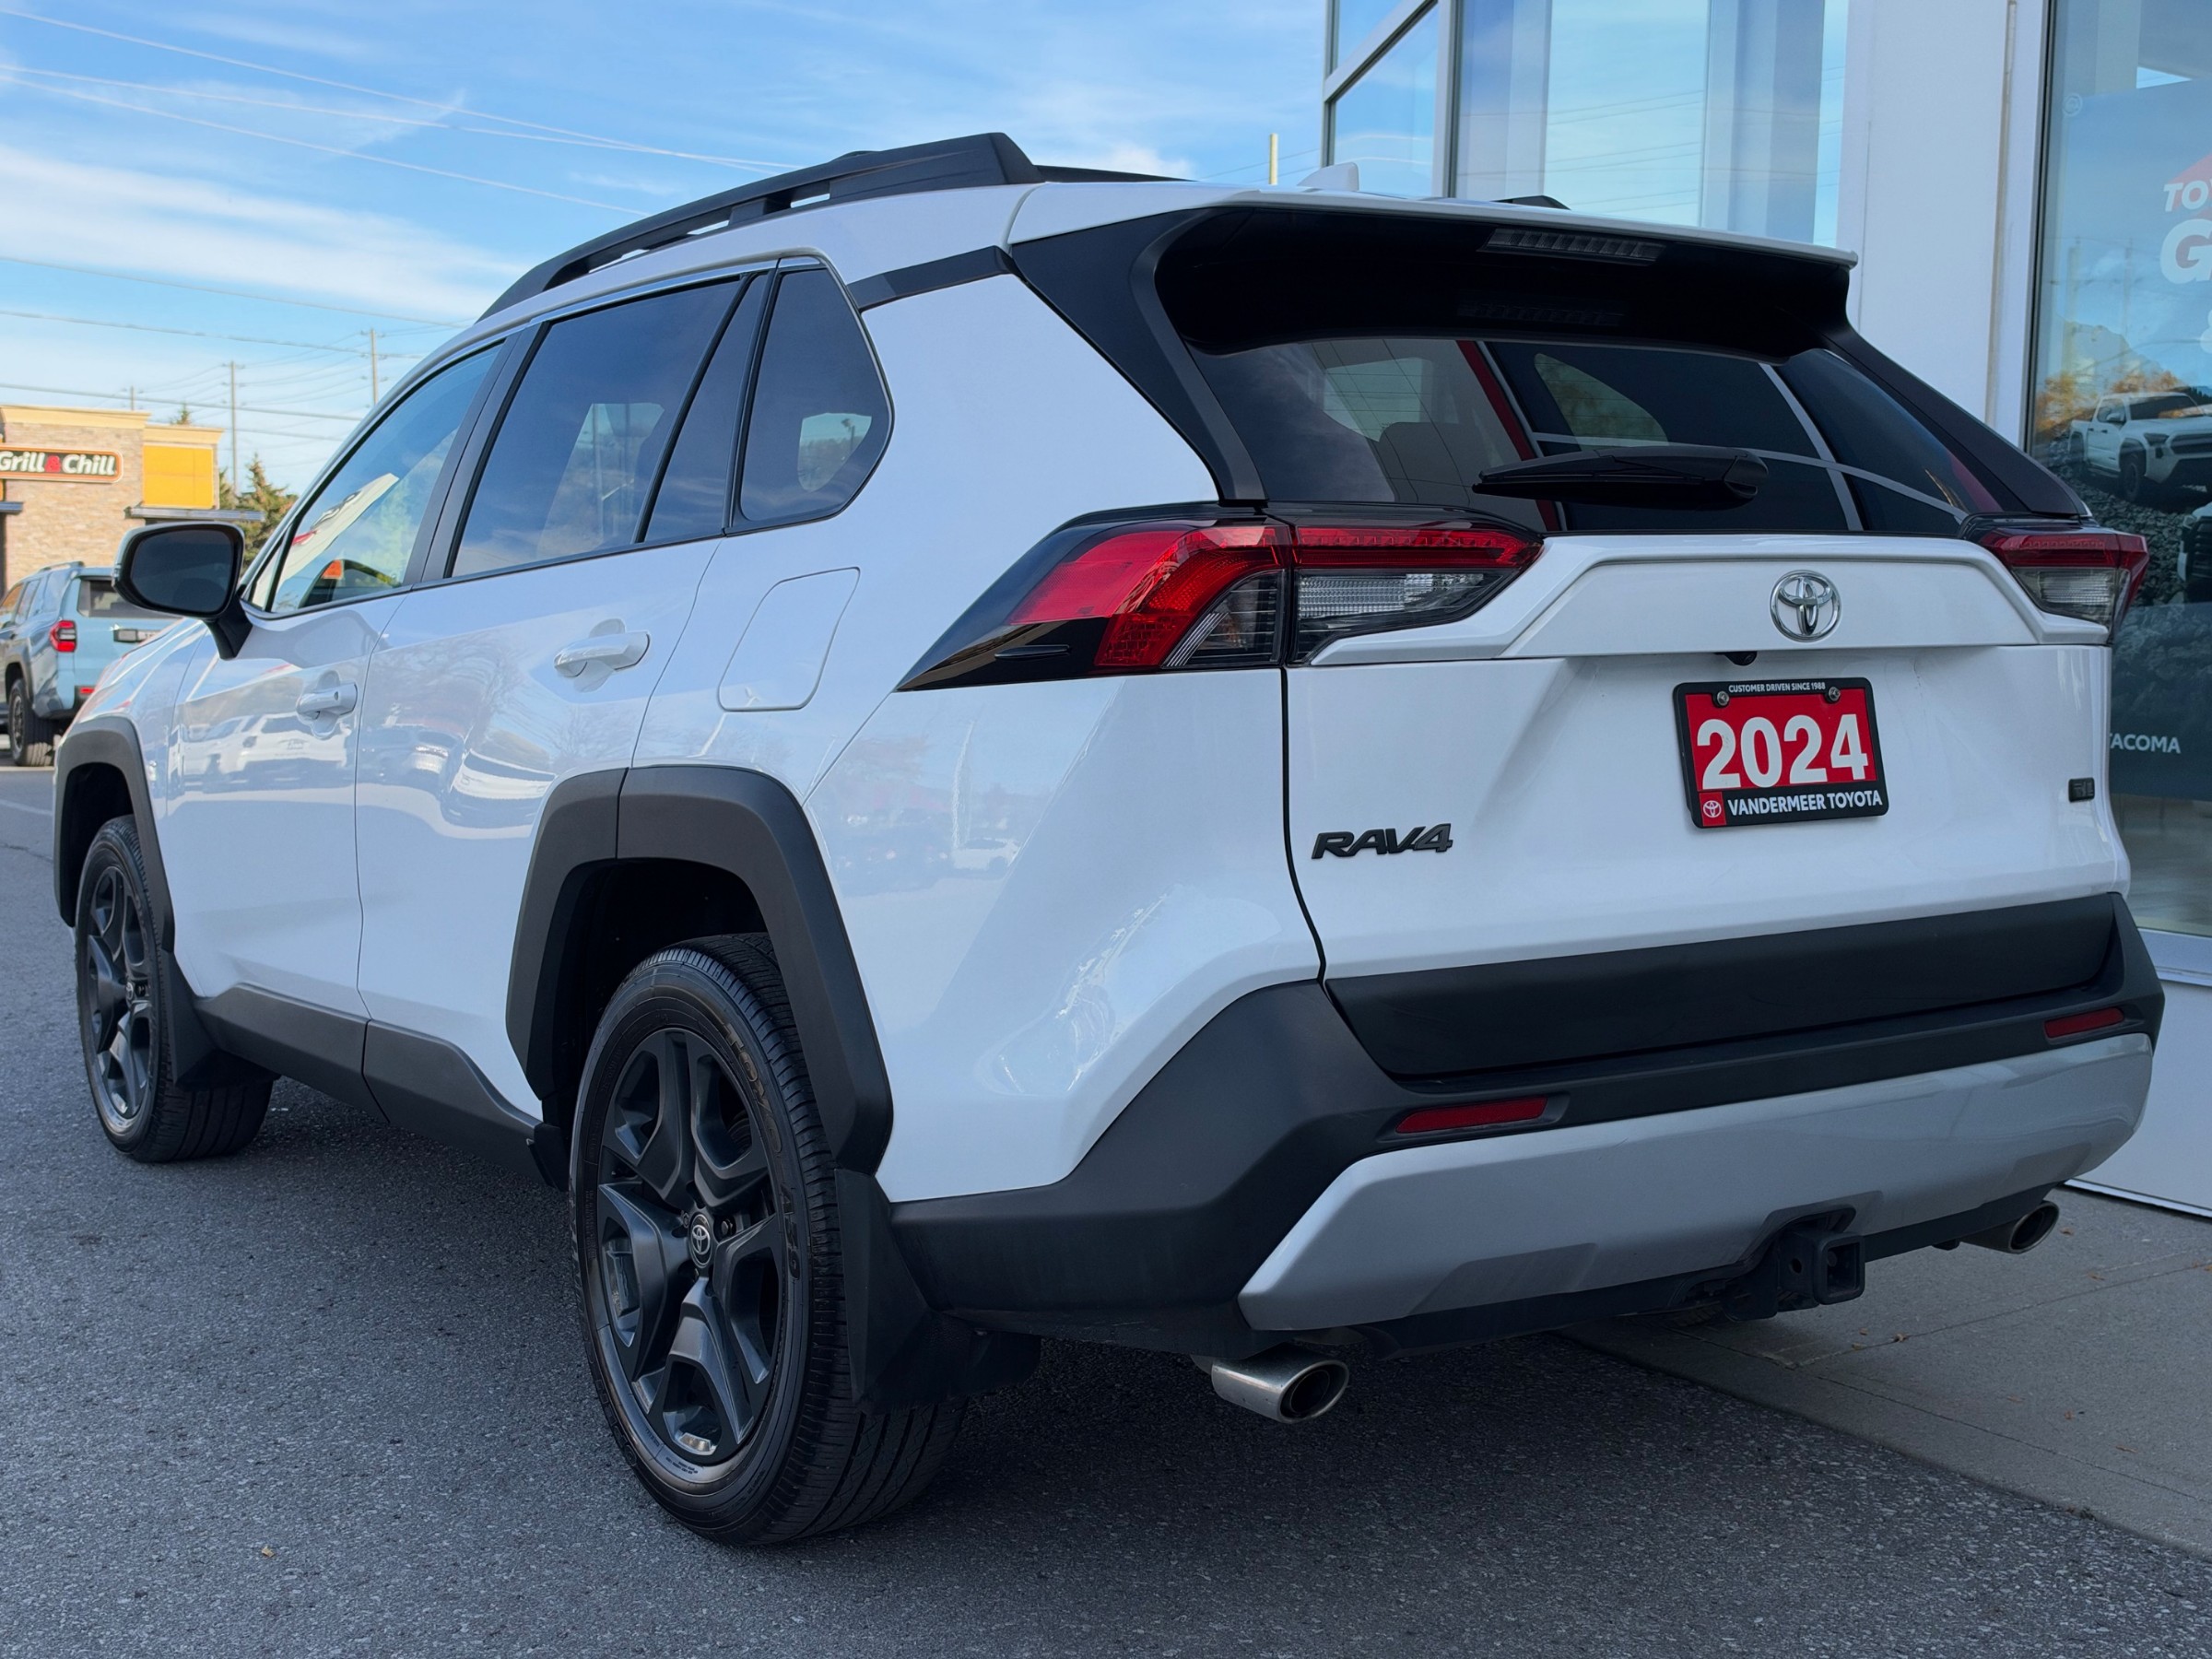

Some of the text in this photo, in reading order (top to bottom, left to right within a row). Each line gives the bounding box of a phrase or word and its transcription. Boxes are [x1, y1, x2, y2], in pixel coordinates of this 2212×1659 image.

[0, 451, 45, 473] Grill
[62, 453, 115, 476] Chill
[1728, 681, 1826, 693] CUSTOMER DRIVEN SINCE 1988
[1697, 713, 1869, 790] 2024
[2110, 733, 2181, 754] ACOMA
[1727, 790, 1883, 816] VANDERMEER TOYOTA
[1312, 823, 1453, 859] RAV4
